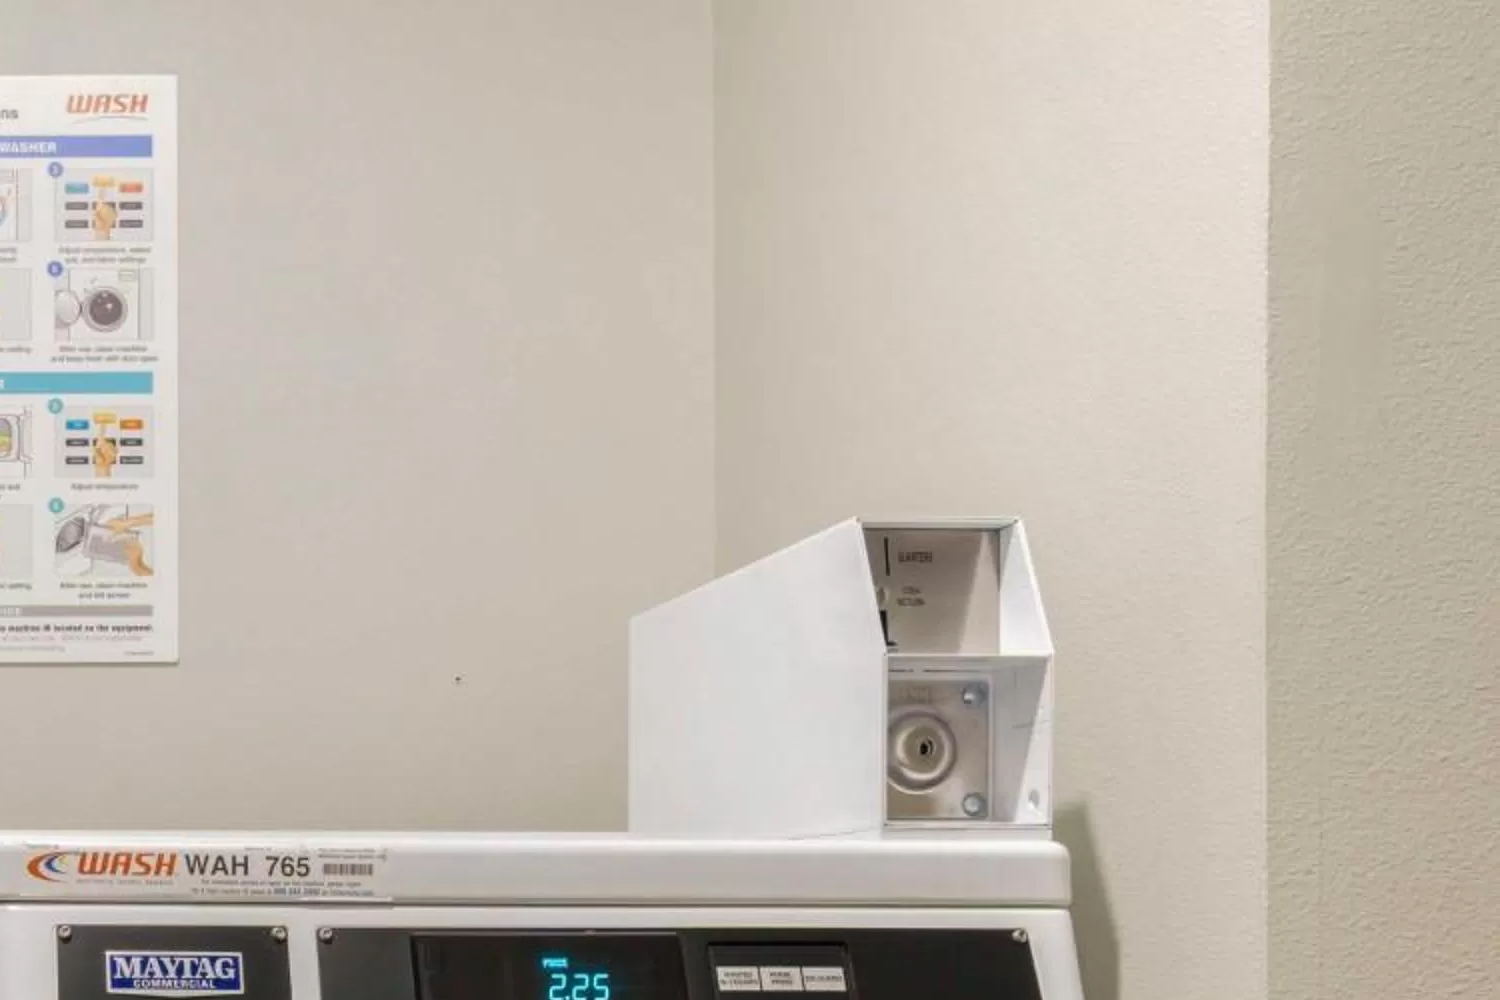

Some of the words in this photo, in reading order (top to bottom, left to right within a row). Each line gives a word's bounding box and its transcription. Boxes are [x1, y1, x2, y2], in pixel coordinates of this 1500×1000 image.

[65, 93, 149, 113] WASH
[78, 852, 177, 877] WASH
[186, 854, 249, 877] WAH
[265, 855, 311, 878] 765
[112, 955, 236, 980] MAYTAG
[132, 978, 217, 990] COMMERCIAL
[549, 973, 609, 1000] 2.25
